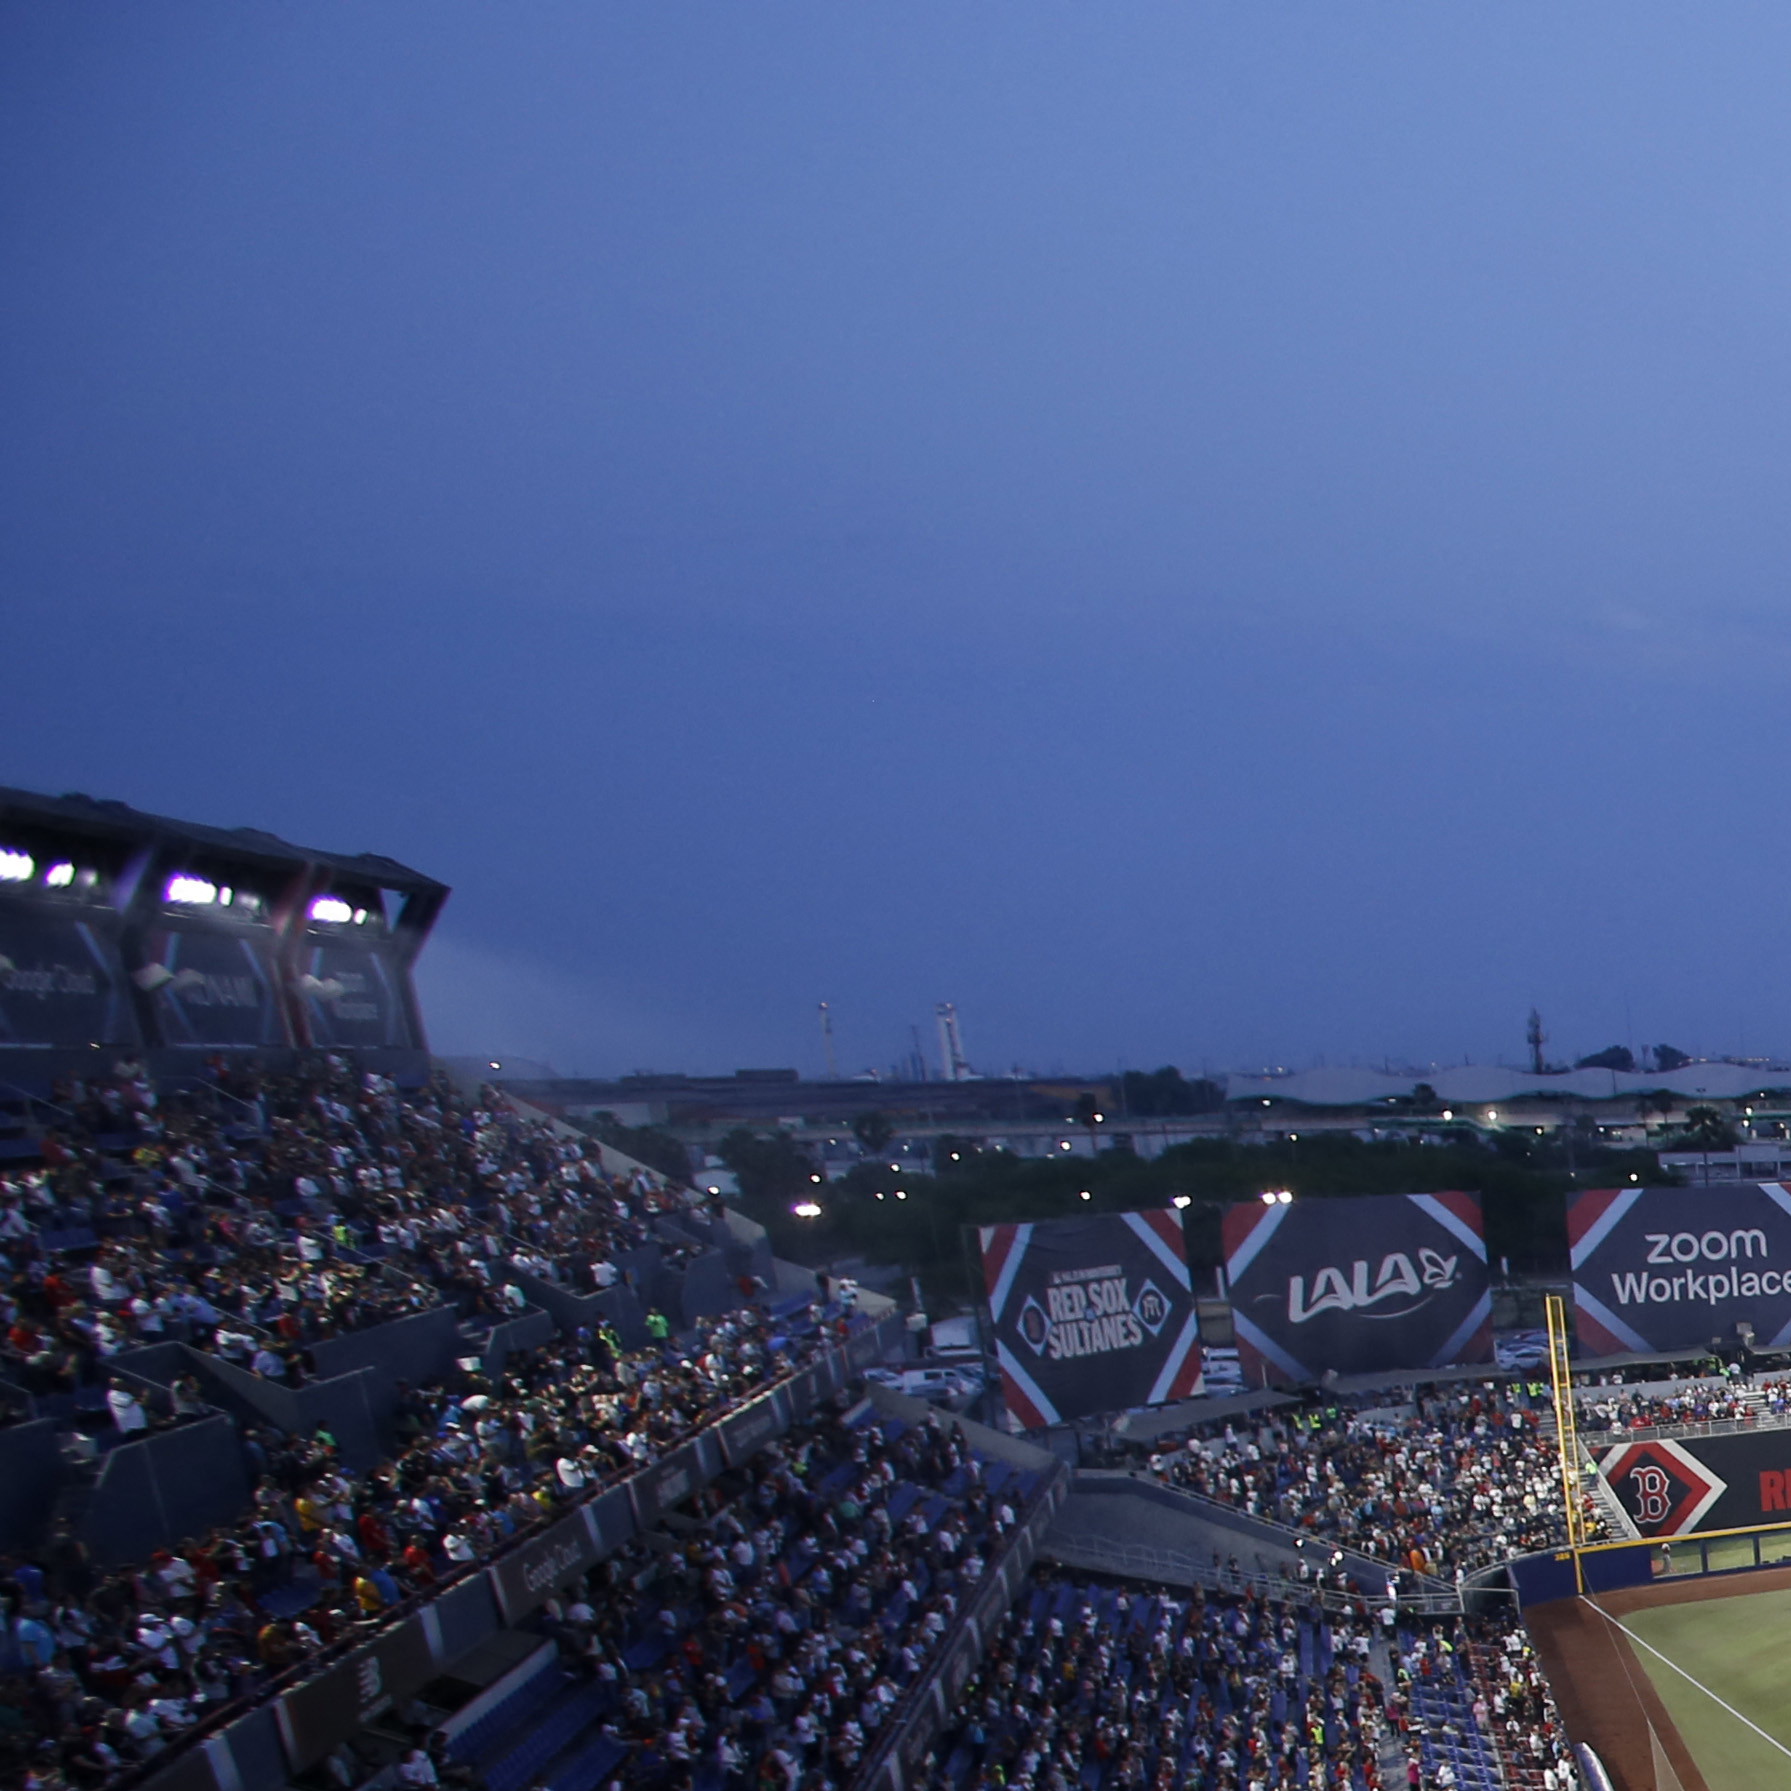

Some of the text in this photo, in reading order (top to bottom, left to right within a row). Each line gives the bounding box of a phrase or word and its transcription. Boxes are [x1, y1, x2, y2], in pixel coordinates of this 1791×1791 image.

[1644, 1228, 1768, 1265] zoom
[1047, 1277, 1131, 1323] RED SOX
[1288, 1252, 1422, 1323] LALA
[1045, 1312, 1144, 1361] SULTANES
